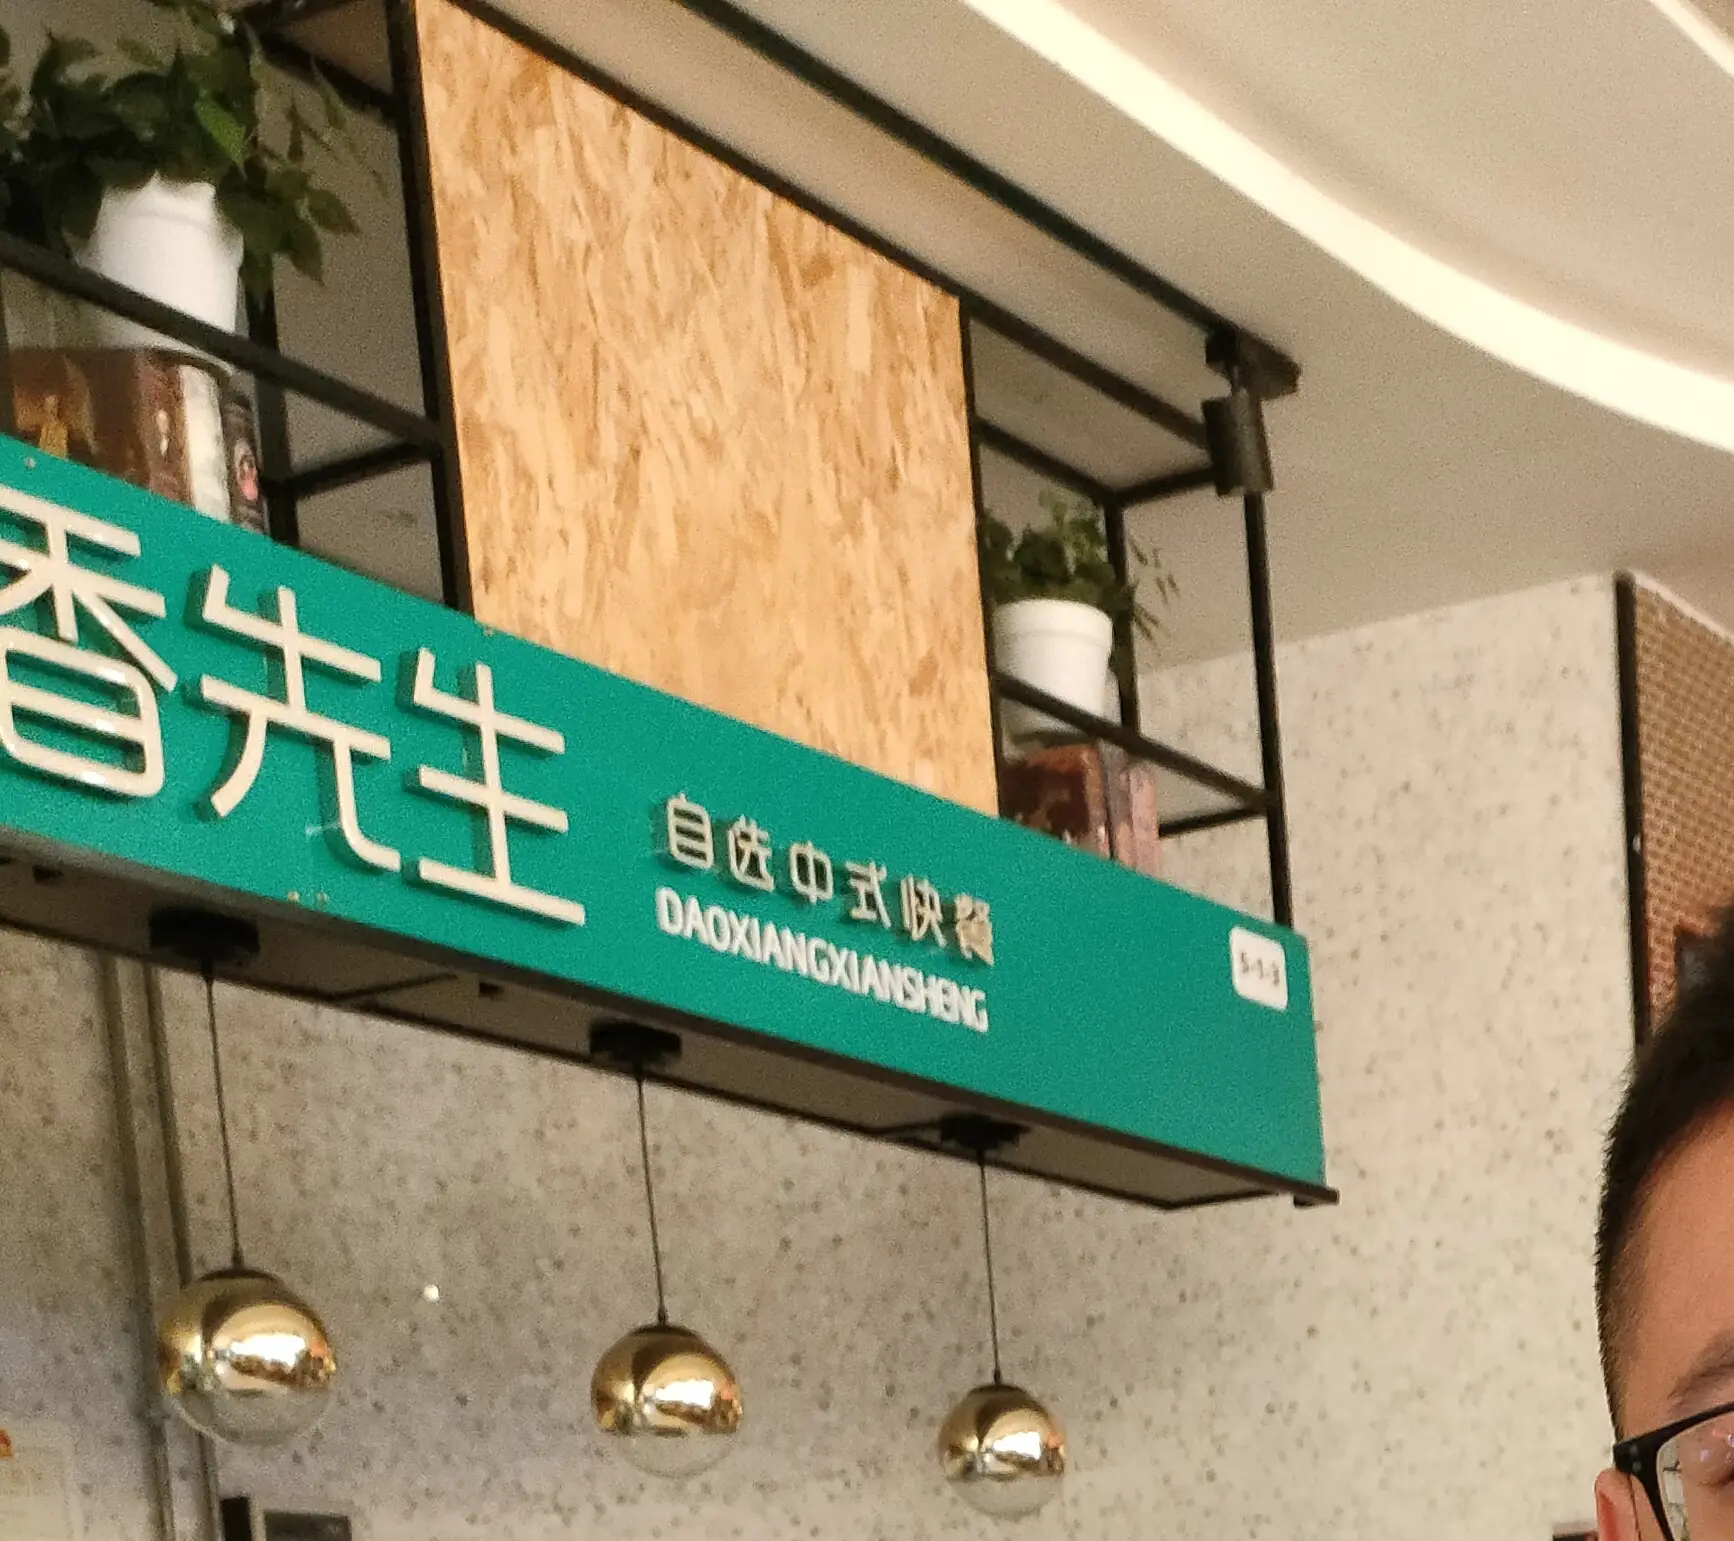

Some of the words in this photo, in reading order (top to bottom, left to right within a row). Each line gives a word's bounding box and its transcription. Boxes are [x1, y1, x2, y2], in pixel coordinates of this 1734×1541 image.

[0, 487, 587, 925] 香先生
[655, 886, 988, 1034] DAOXIANGXIANSHENG
[666, 792, 994, 967] 自选中式快餐
